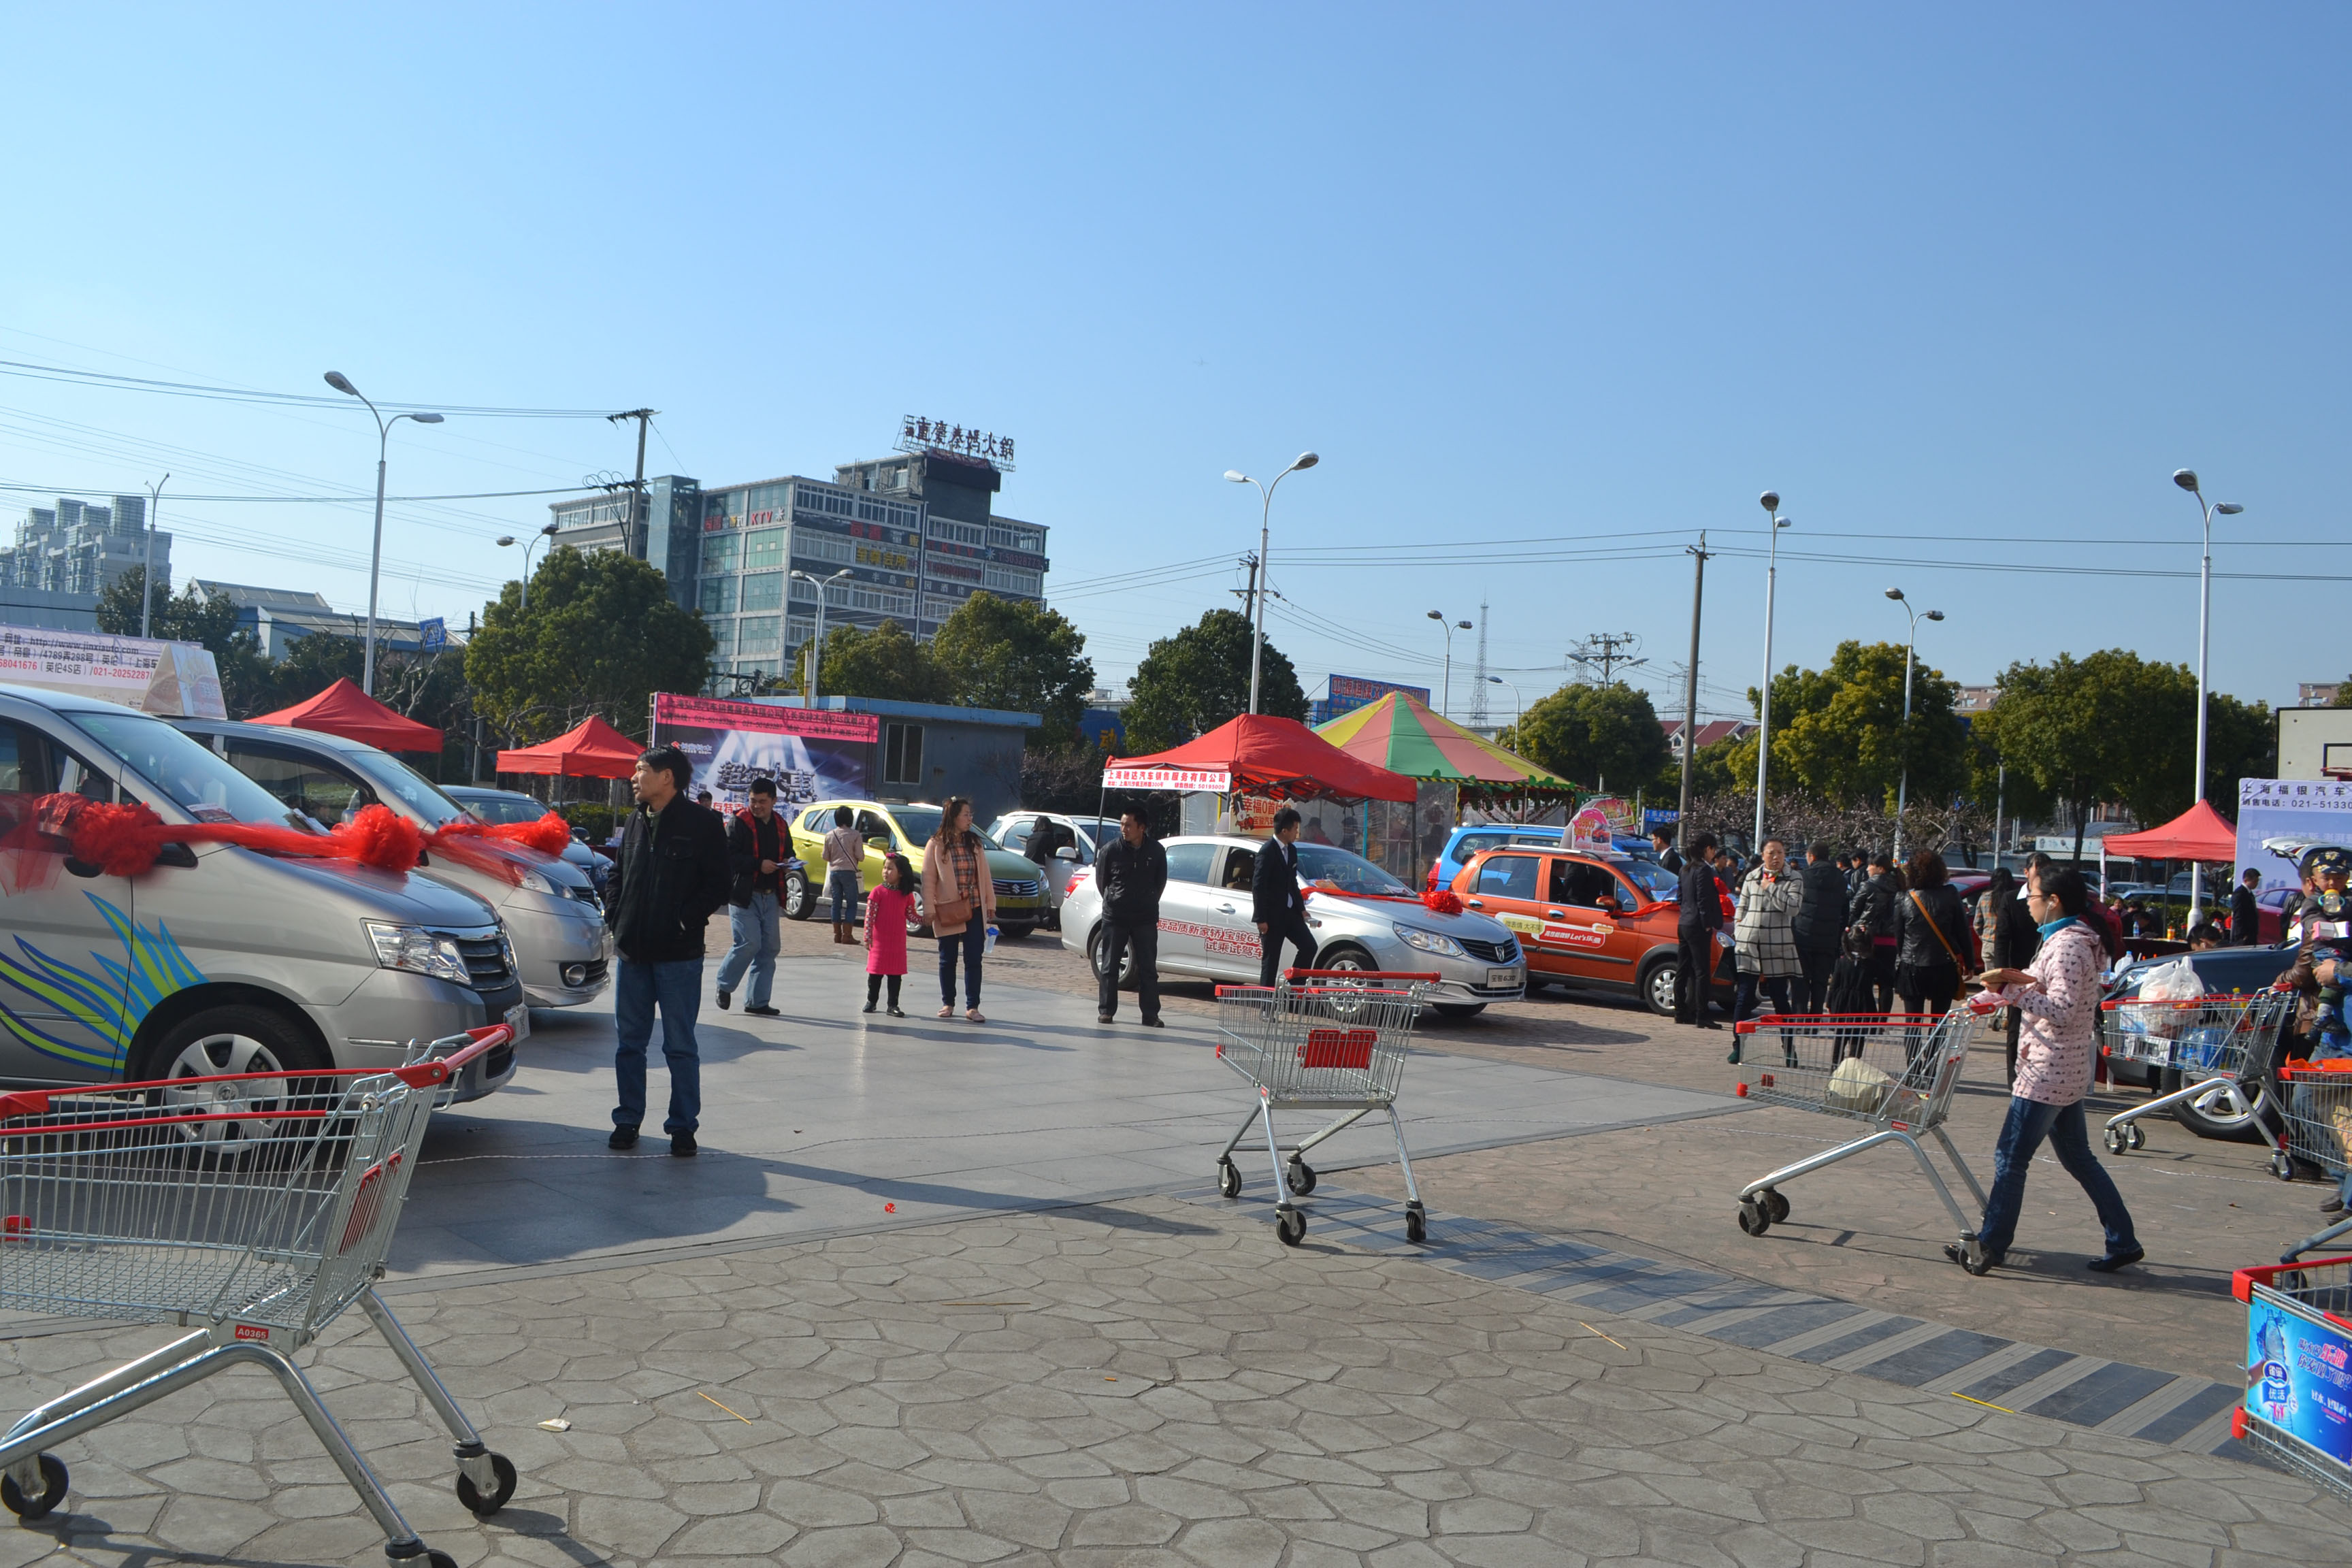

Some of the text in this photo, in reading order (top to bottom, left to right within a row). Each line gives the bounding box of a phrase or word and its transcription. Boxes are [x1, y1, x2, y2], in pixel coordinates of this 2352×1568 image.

[751, 511, 772, 525] KTV
[941, 542, 975, 557] KTV
[30, 636, 139, 655] http://www.jinxiauto.com
[238, 1328, 266, 1339] A0365
